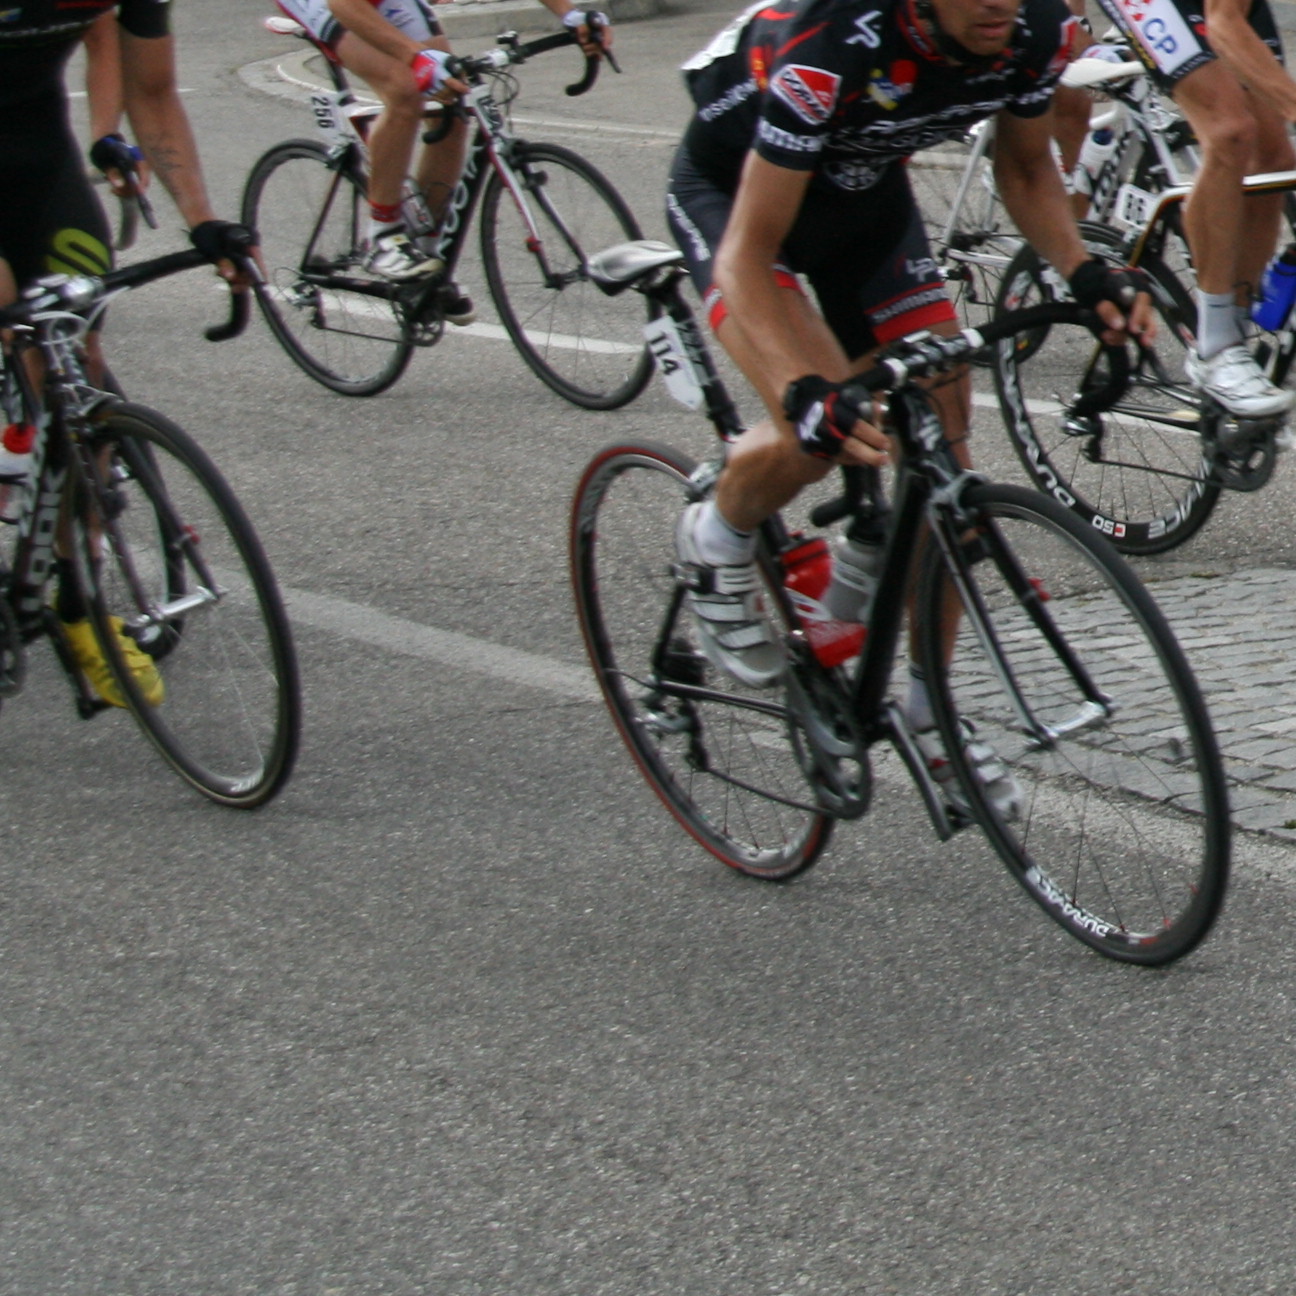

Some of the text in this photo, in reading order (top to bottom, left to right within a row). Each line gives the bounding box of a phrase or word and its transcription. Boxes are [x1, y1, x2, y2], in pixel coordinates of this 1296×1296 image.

[1142, 17, 1178, 55] CP
[311, 96, 335, 129] 256
[649, 332, 680, 376] 114
[1092, 513, 1127, 539] C50
